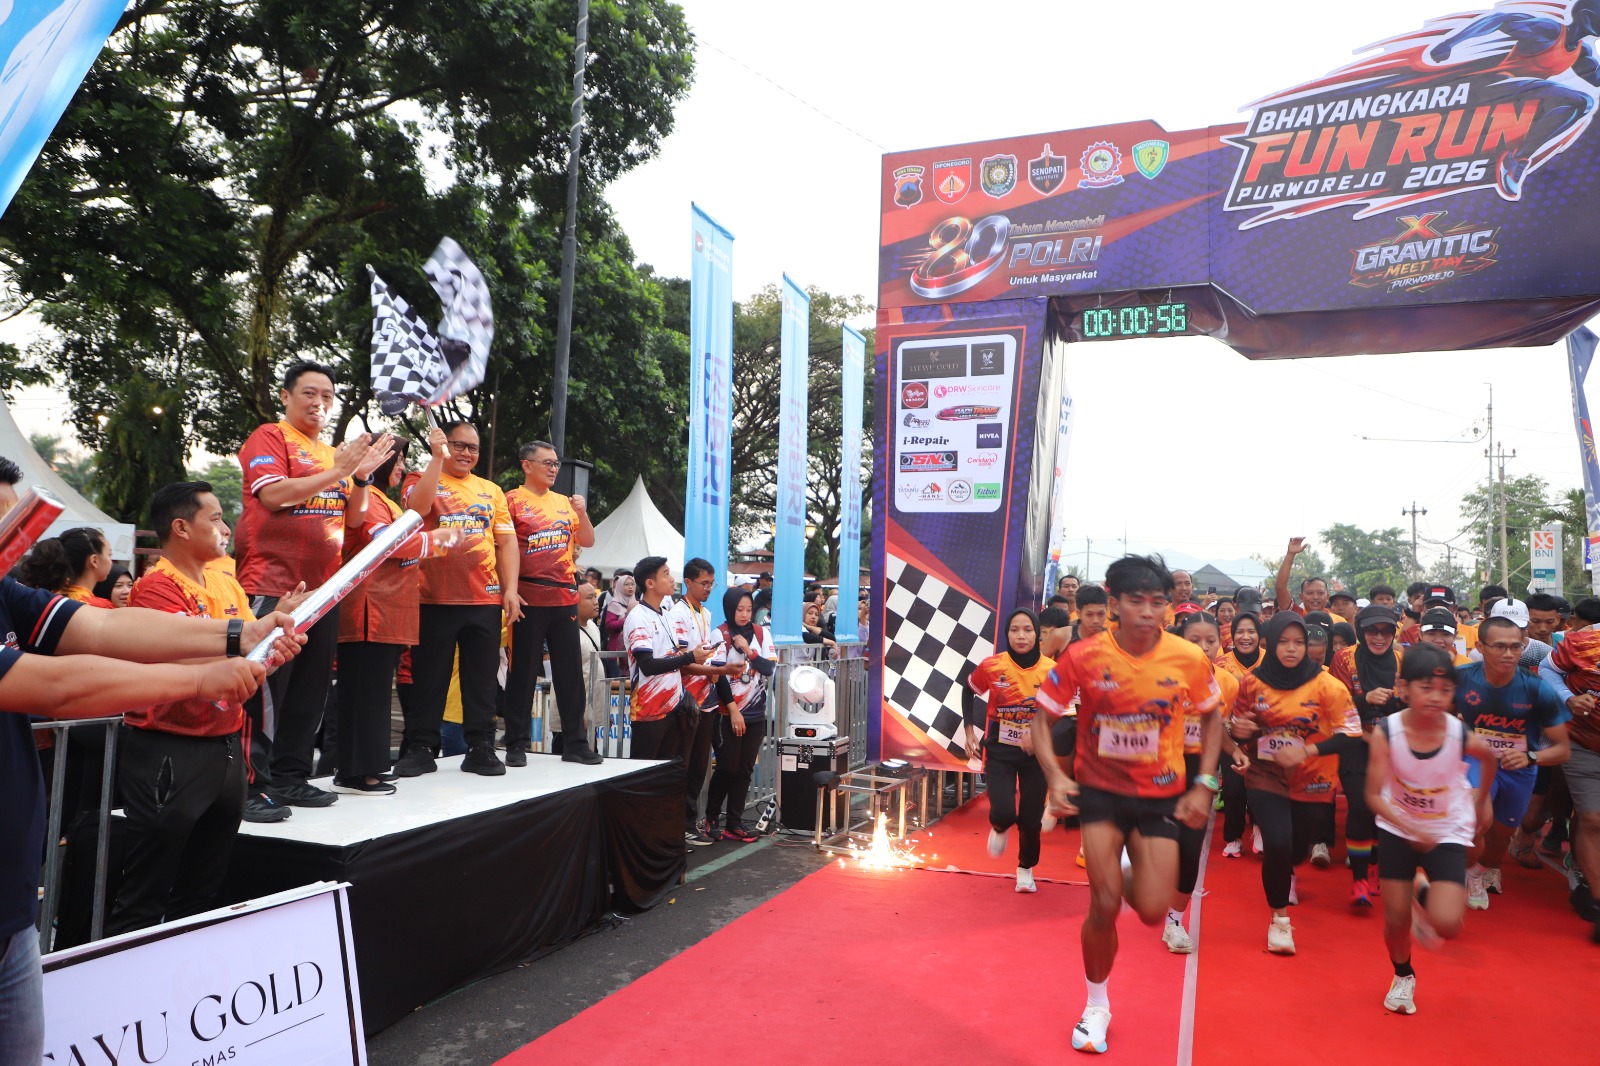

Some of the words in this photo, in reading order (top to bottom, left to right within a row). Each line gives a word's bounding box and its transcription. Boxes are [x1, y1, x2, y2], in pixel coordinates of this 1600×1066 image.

[1256, 82, 1471, 134] BHAYANGKARA
[1136, 141, 1166, 151] INDONESIA
[1243, 120, 1382, 184] FUN
[1386, 97, 1541, 167] RUN
[933, 159, 971, 169] DIPONEGORO
[1031, 165, 1063, 176] SENOPATI
[1236, 171, 1386, 203] PURWOREJO
[1402, 157, 1490, 190] 2026
[1008, 222, 1043, 235] Tahun
[1044, 214, 1105, 232] Mengabdi
[1008, 235, 1103, 269] POLRI
[1354, 230, 1494, 272] GRAVITIC
[1382, 260, 1430, 281] MEET
[1432, 254, 1467, 272] DAY
[1009, 274, 1039, 286] Untuk
[1040, 269, 1098, 285] Masyarakat
[1391, 269, 1455, 290] PURWOREJO
[1084, 303, 1186, 337] 00:00:56
[947, 385, 967, 393] DRW
[967, 384, 1001, 393] Skincare
[903, 436, 950, 447] i-Repair
[703, 413, 726, 507] BRI
[786, 449, 803, 527] BRI
[976, 487, 998, 496] Fitbar
[326, 498, 345, 511] RUN
[528, 536, 551, 551] FUN
[551, 534, 569, 545] RUN
[1534, 549, 1553, 558] BNI
[1502, 608, 1519, 616] osaka
[1486, 738, 1516, 749] 3082
[190, 960, 323, 1042] GOLD
